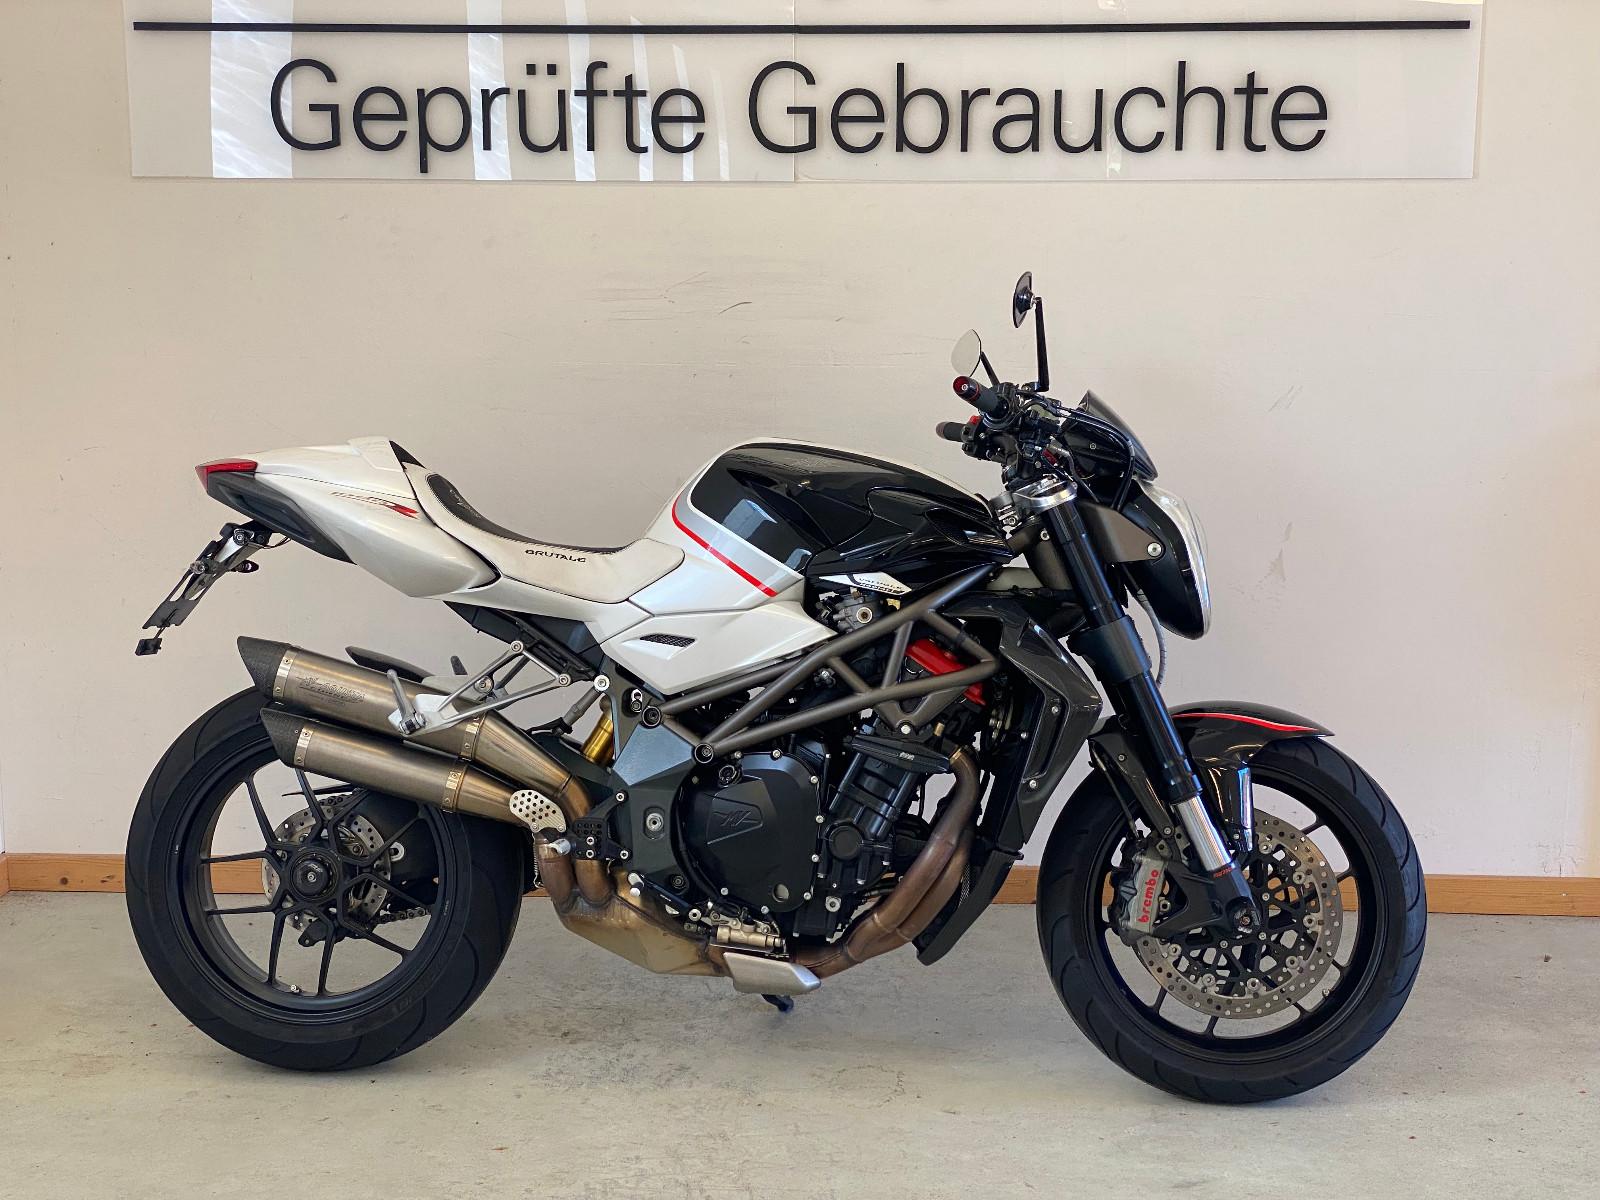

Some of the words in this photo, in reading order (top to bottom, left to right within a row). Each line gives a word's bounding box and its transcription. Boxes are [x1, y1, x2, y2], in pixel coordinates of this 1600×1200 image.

[270, 58, 706, 174] Geprüfte
[748, 60, 1328, 153] Gebrauchte
[525, 549, 587, 563] BRUTALE
[1138, 869, 1159, 923] brembo
